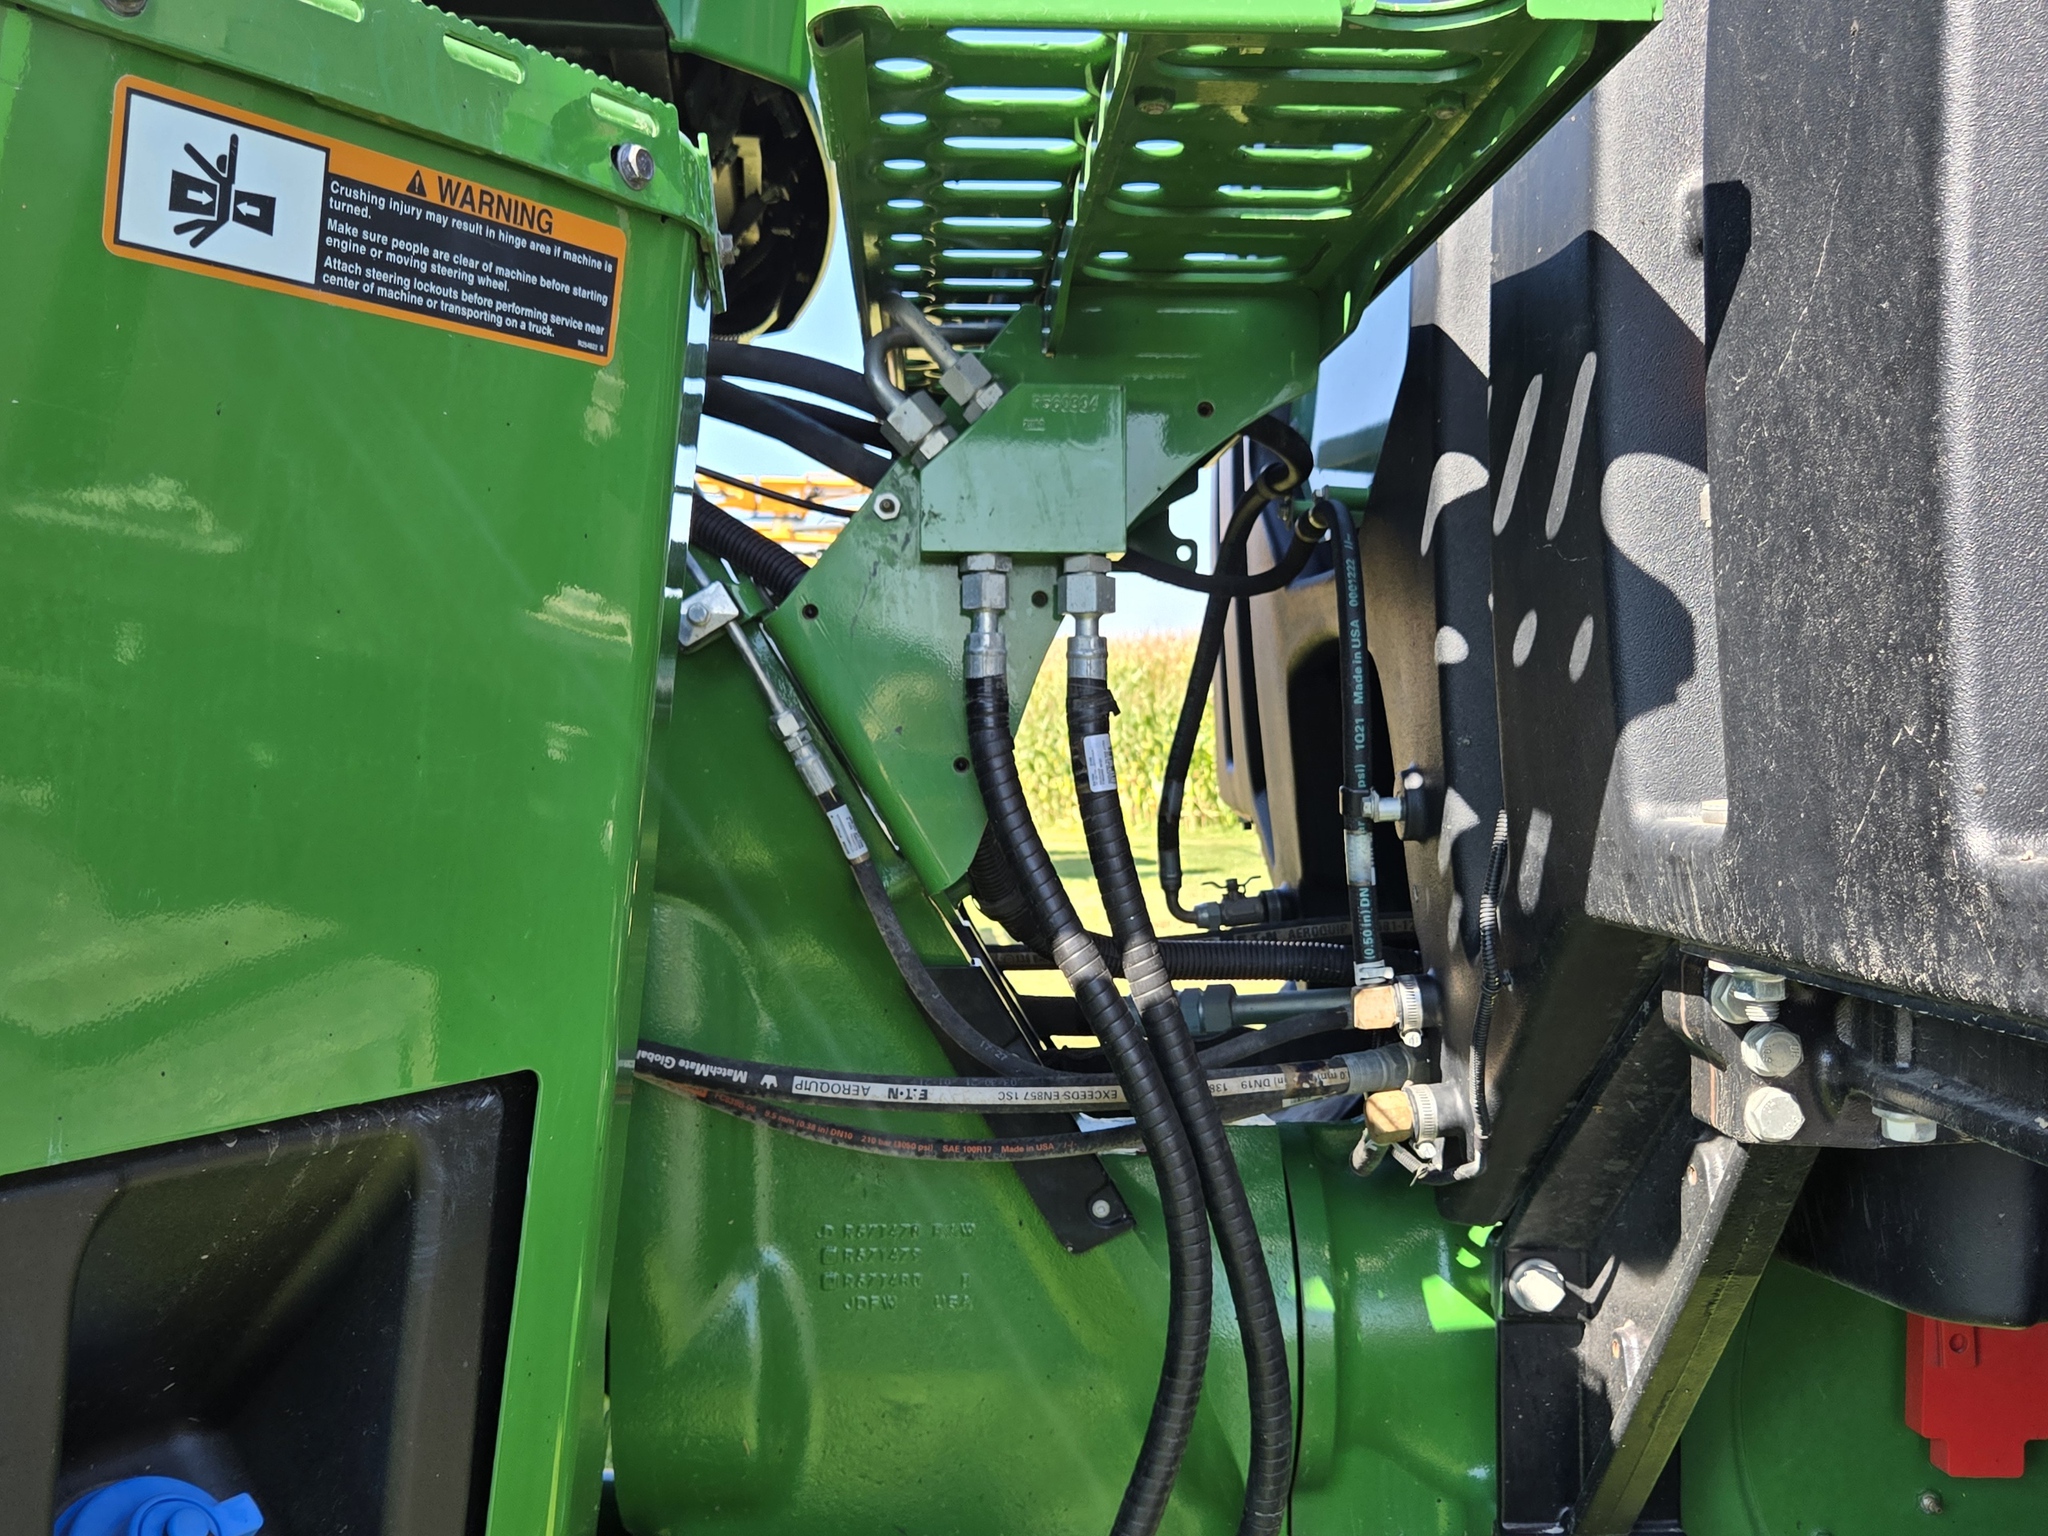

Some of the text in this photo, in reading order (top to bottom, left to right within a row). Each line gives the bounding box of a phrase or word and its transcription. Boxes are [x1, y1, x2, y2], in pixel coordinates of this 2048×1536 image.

[329, 196, 372, 219] turned.
[437, 175, 554, 235] WARNING
[330, 180, 613, 273] Crushing injury may result in hinge area if machine is
[325, 236, 510, 293] engine or moving steering wheel.
[327, 217, 608, 307] Make sure people are clear of machine before starting
[322, 273, 555, 337] center of machine or transporting on a truck.
[323, 255, 605, 336] Attach steering lockouts before performing service near
[1350, 619, 1361, 649] USA
[1353, 651, 1362, 664] in
[1353, 666, 1364, 705] Made
[1354, 718, 1366, 751] 1Q21
[1362, 929, 1375, 960] (0.50
[636, 1049, 676, 1070] Global
[678, 1058, 748, 1084] MatchMate
[794, 1079, 871, 1097] AEROQUIP
[997, 1090, 1019, 1101] 1SC
[1023, 1090, 1060, 1101] EN857
[1063, 1089, 1118, 1100] EXCEEDS
[1240, 1077, 1271, 1089] DN19
[764, 1109, 777, 1120] 9.5
[778, 1115, 795, 1126] mm
[829, 1128, 853, 1140] DN10
[860, 1135, 876, 1145] 210
[942, 1144, 960, 1153] SAE
[962, 1145, 993, 1154] 100R17
[1000, 1144, 1025, 1153] Made
[1025, 1144, 1035, 1152] in
[1035, 1142, 1055, 1152] USA
